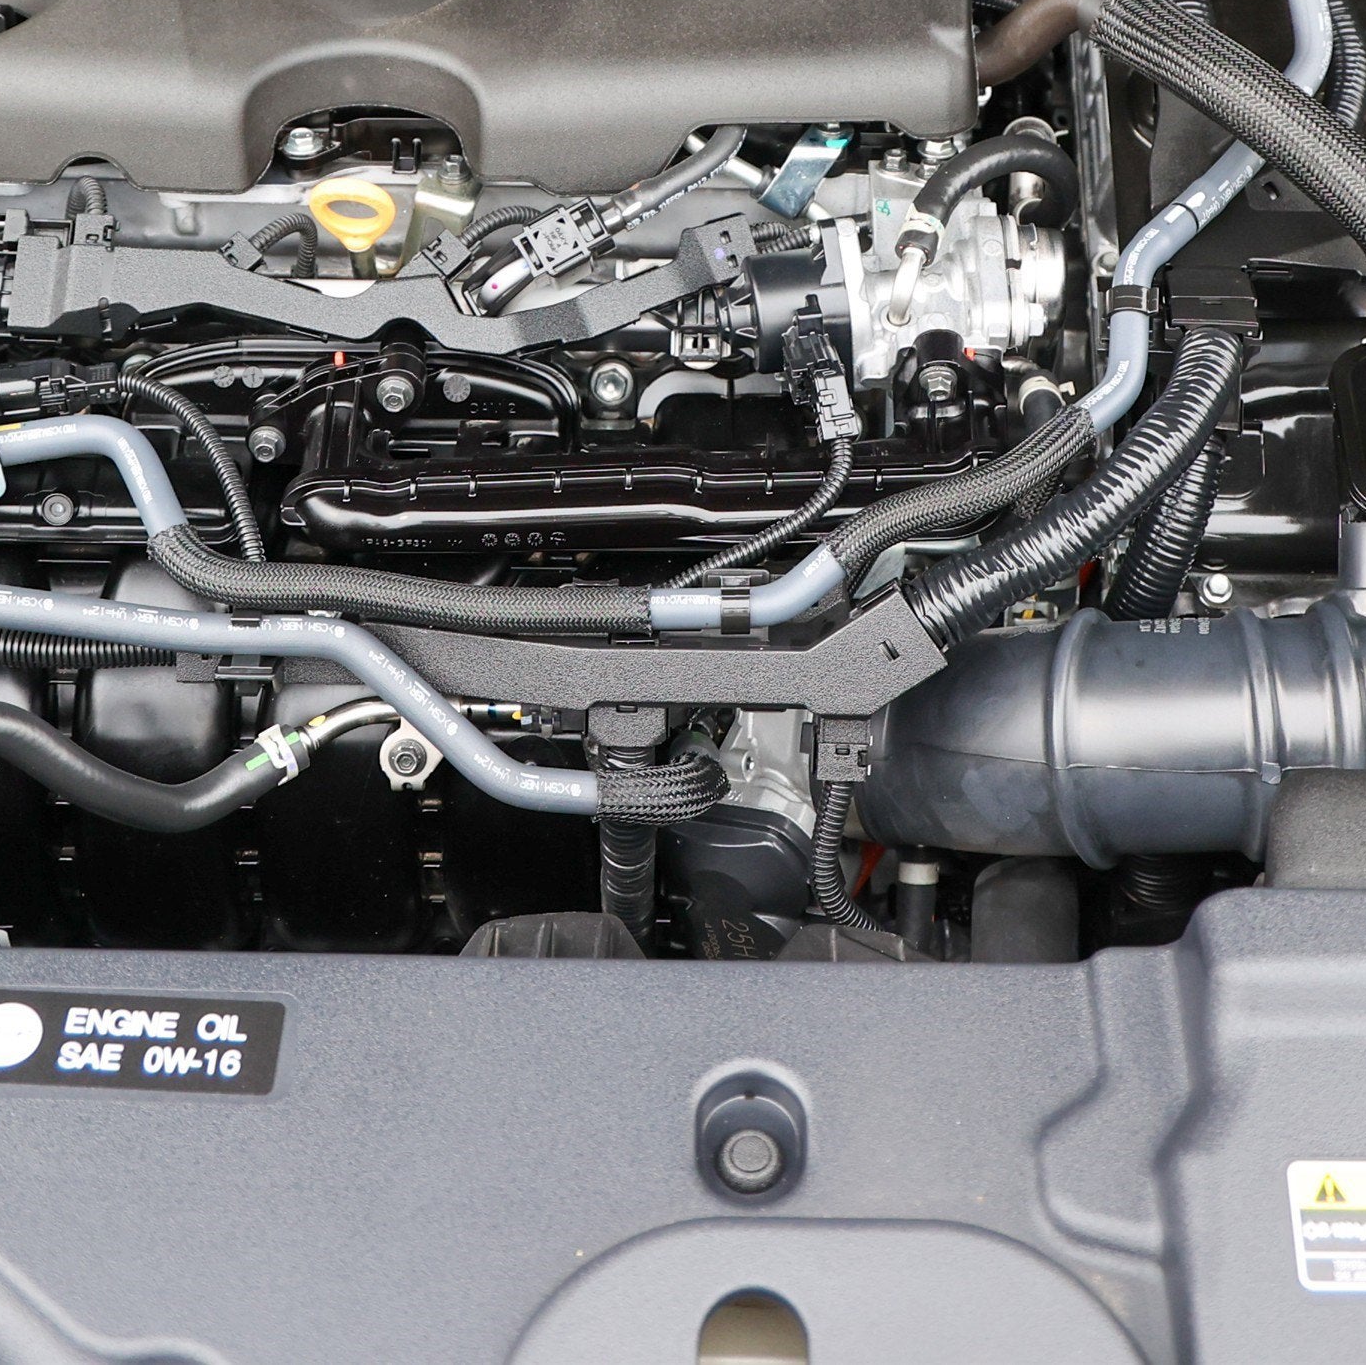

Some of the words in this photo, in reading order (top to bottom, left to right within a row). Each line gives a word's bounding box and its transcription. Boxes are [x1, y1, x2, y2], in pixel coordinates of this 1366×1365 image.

[64, 1007, 180, 1040] ENGINE
[196, 1014, 248, 1042] OIL
[57, 1041, 124, 1072] SAE
[142, 1045, 242, 1077] 0W-16
